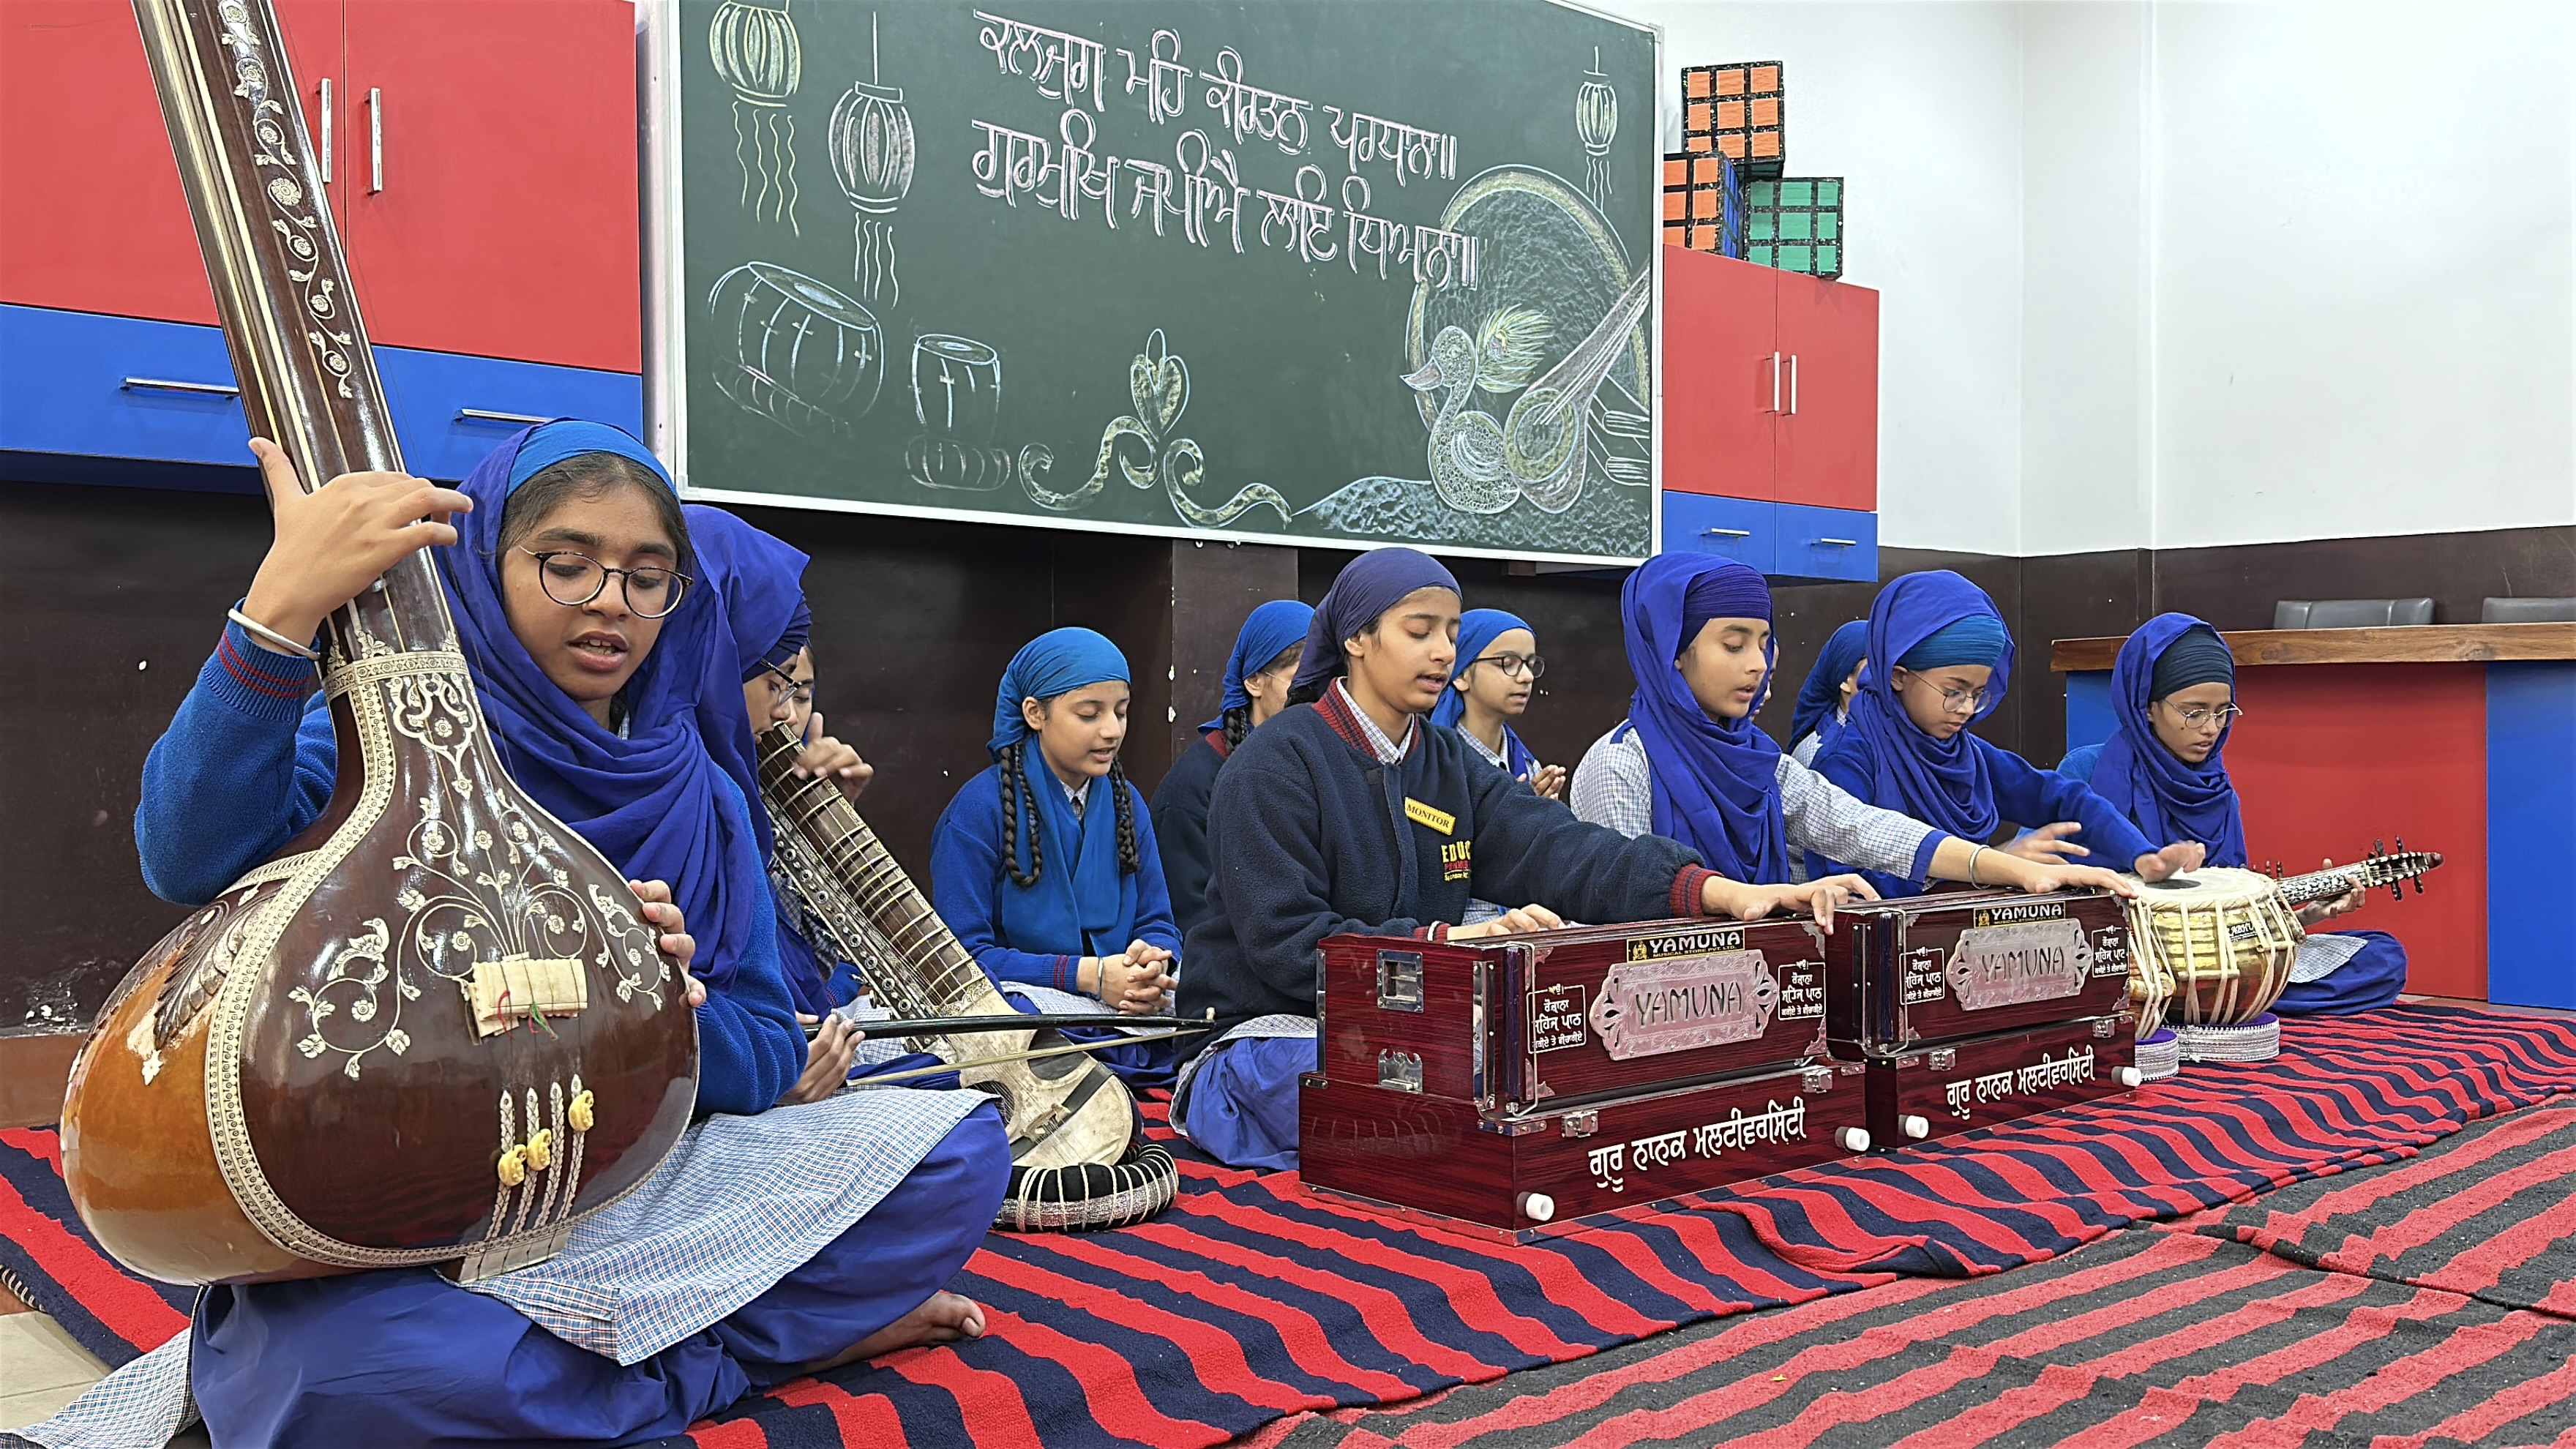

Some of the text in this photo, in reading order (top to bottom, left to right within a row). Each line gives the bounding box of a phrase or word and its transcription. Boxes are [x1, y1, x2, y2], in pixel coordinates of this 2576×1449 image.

[974, 9, 1106, 111] ਕਲਜੁਗ
[1116, 29, 1193, 124] ਮਹਿ
[1199, 46, 1313, 154] ਕੀਰਤਨੁ
[972, 108, 1120, 229] ਗੁਰਮੁਖਿ
[1124, 130, 1251, 254] ਜਪੀਐ
[1407, 804, 1450, 828] MONITOR
[1992, 904, 2062, 921] YAMUNA
[1650, 932, 1740, 954] YAMUNA
[1981, 946, 2065, 982] YAMUNA
[1636, 981, 1742, 1029] YAMUNA
[1781, 984, 1822, 1003] ਸਹਿਜ ਪਾਠ
[1561, 1013, 1582, 1029] ਪਾਠ
[1946, 1079, 1971, 1120] ਗੁਰੂ
[1975, 1071, 2013, 1103] ਨਾਨਕ
[1588, 1144, 1625, 1192] ਗੁਰੂ
[1631, 1130, 1687, 1170] ਨਾਨਕ
